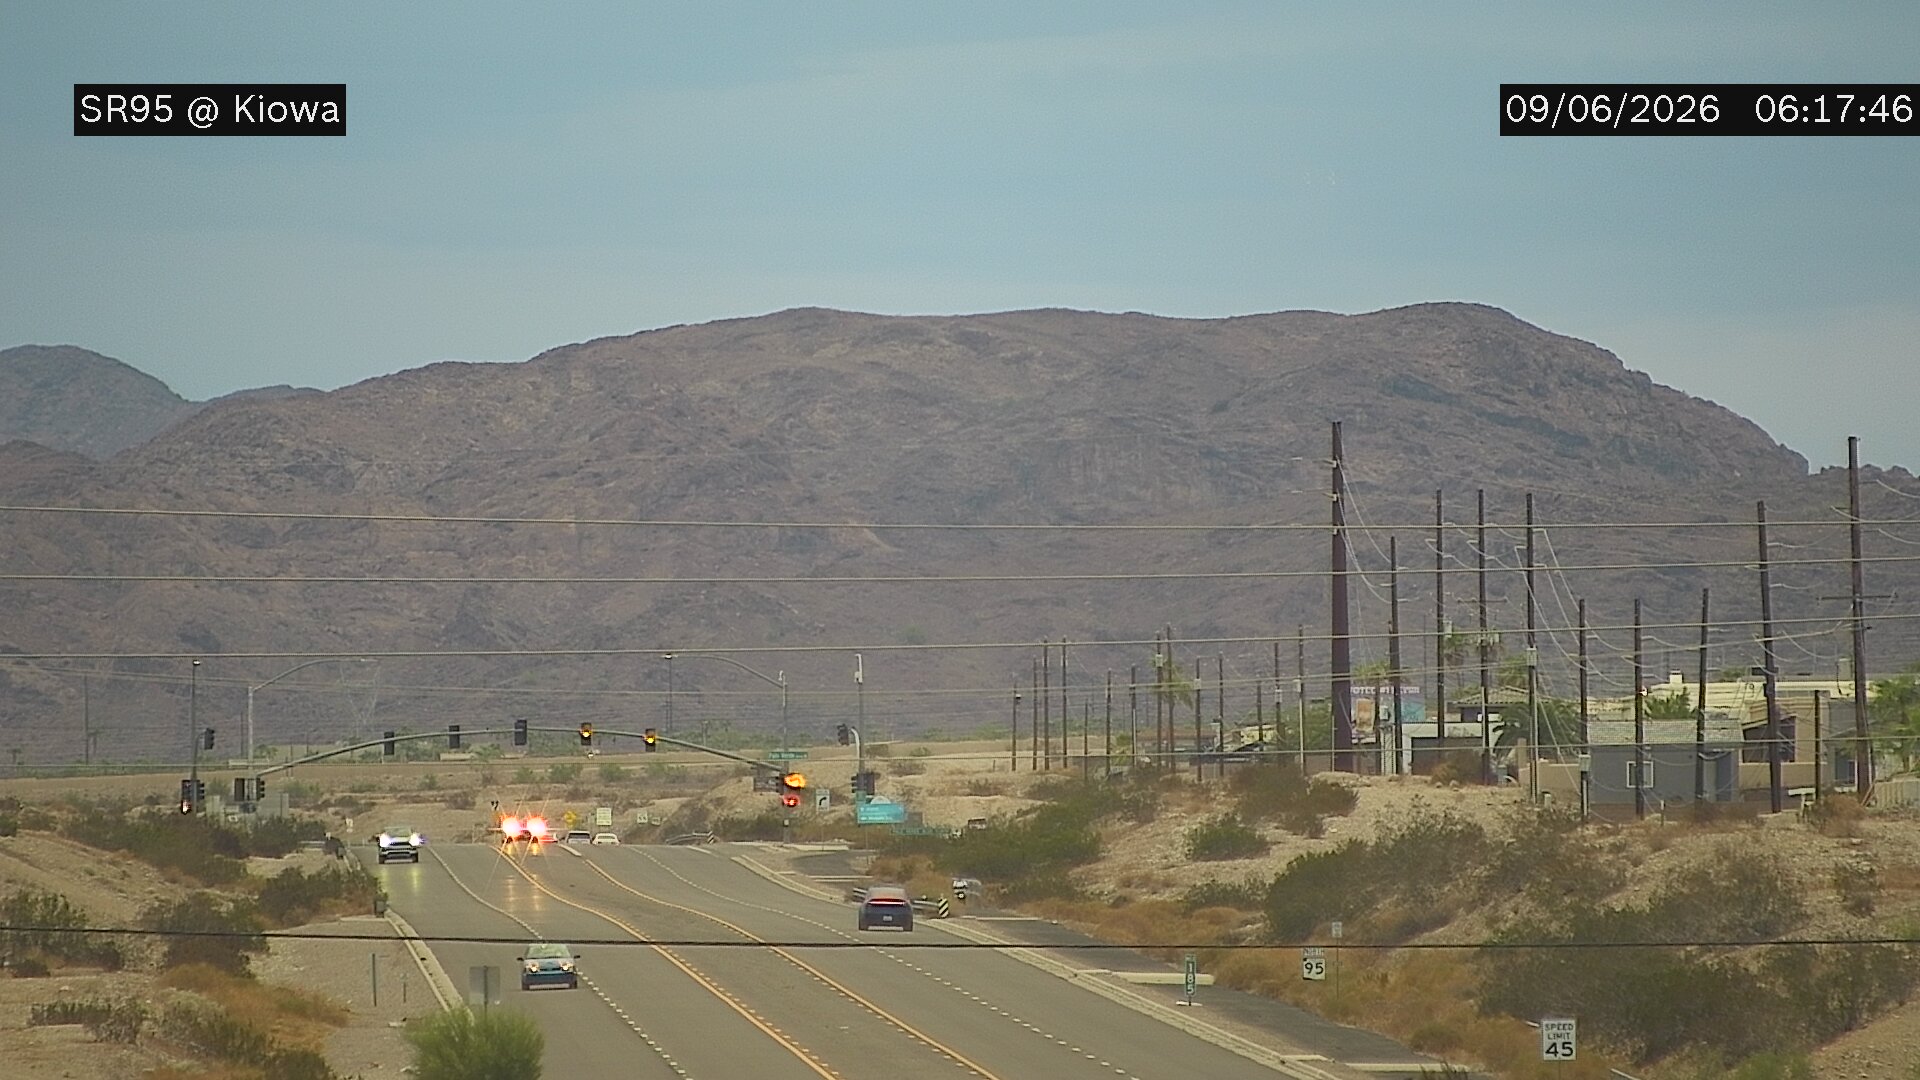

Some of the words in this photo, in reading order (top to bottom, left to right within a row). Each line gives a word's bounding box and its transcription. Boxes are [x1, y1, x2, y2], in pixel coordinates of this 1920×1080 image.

[1304, 962, 1324, 975] 95
[1545, 1023, 1574, 1031] SPEED
[1547, 1032, 1571, 1040] LIMIT
[1545, 1041, 1574, 1057] 45
